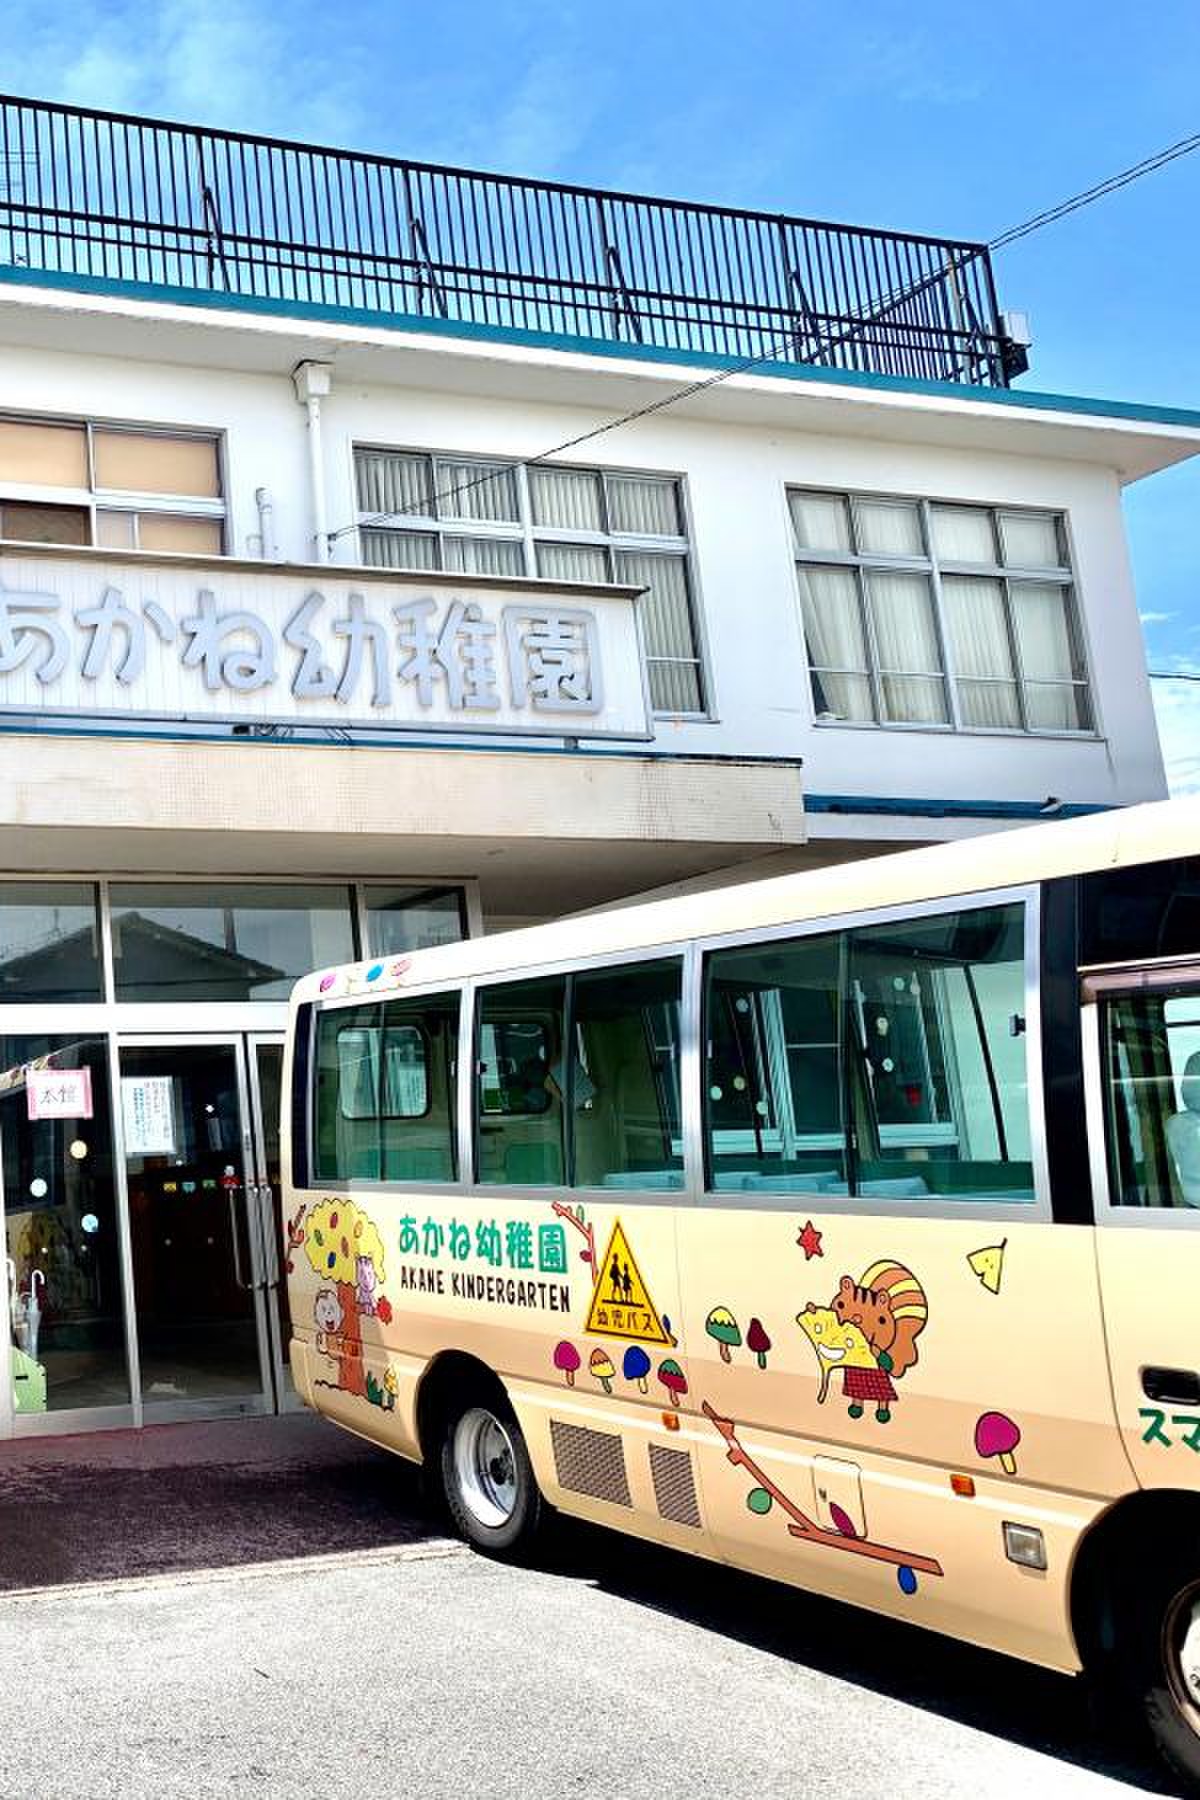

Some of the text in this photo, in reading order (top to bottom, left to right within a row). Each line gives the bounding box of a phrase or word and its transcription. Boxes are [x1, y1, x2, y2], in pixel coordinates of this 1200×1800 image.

[399, 1214, 568, 1274] あかね幼稚園
[400, 1266, 571, 1313] AKANE KINDERGARTEN
